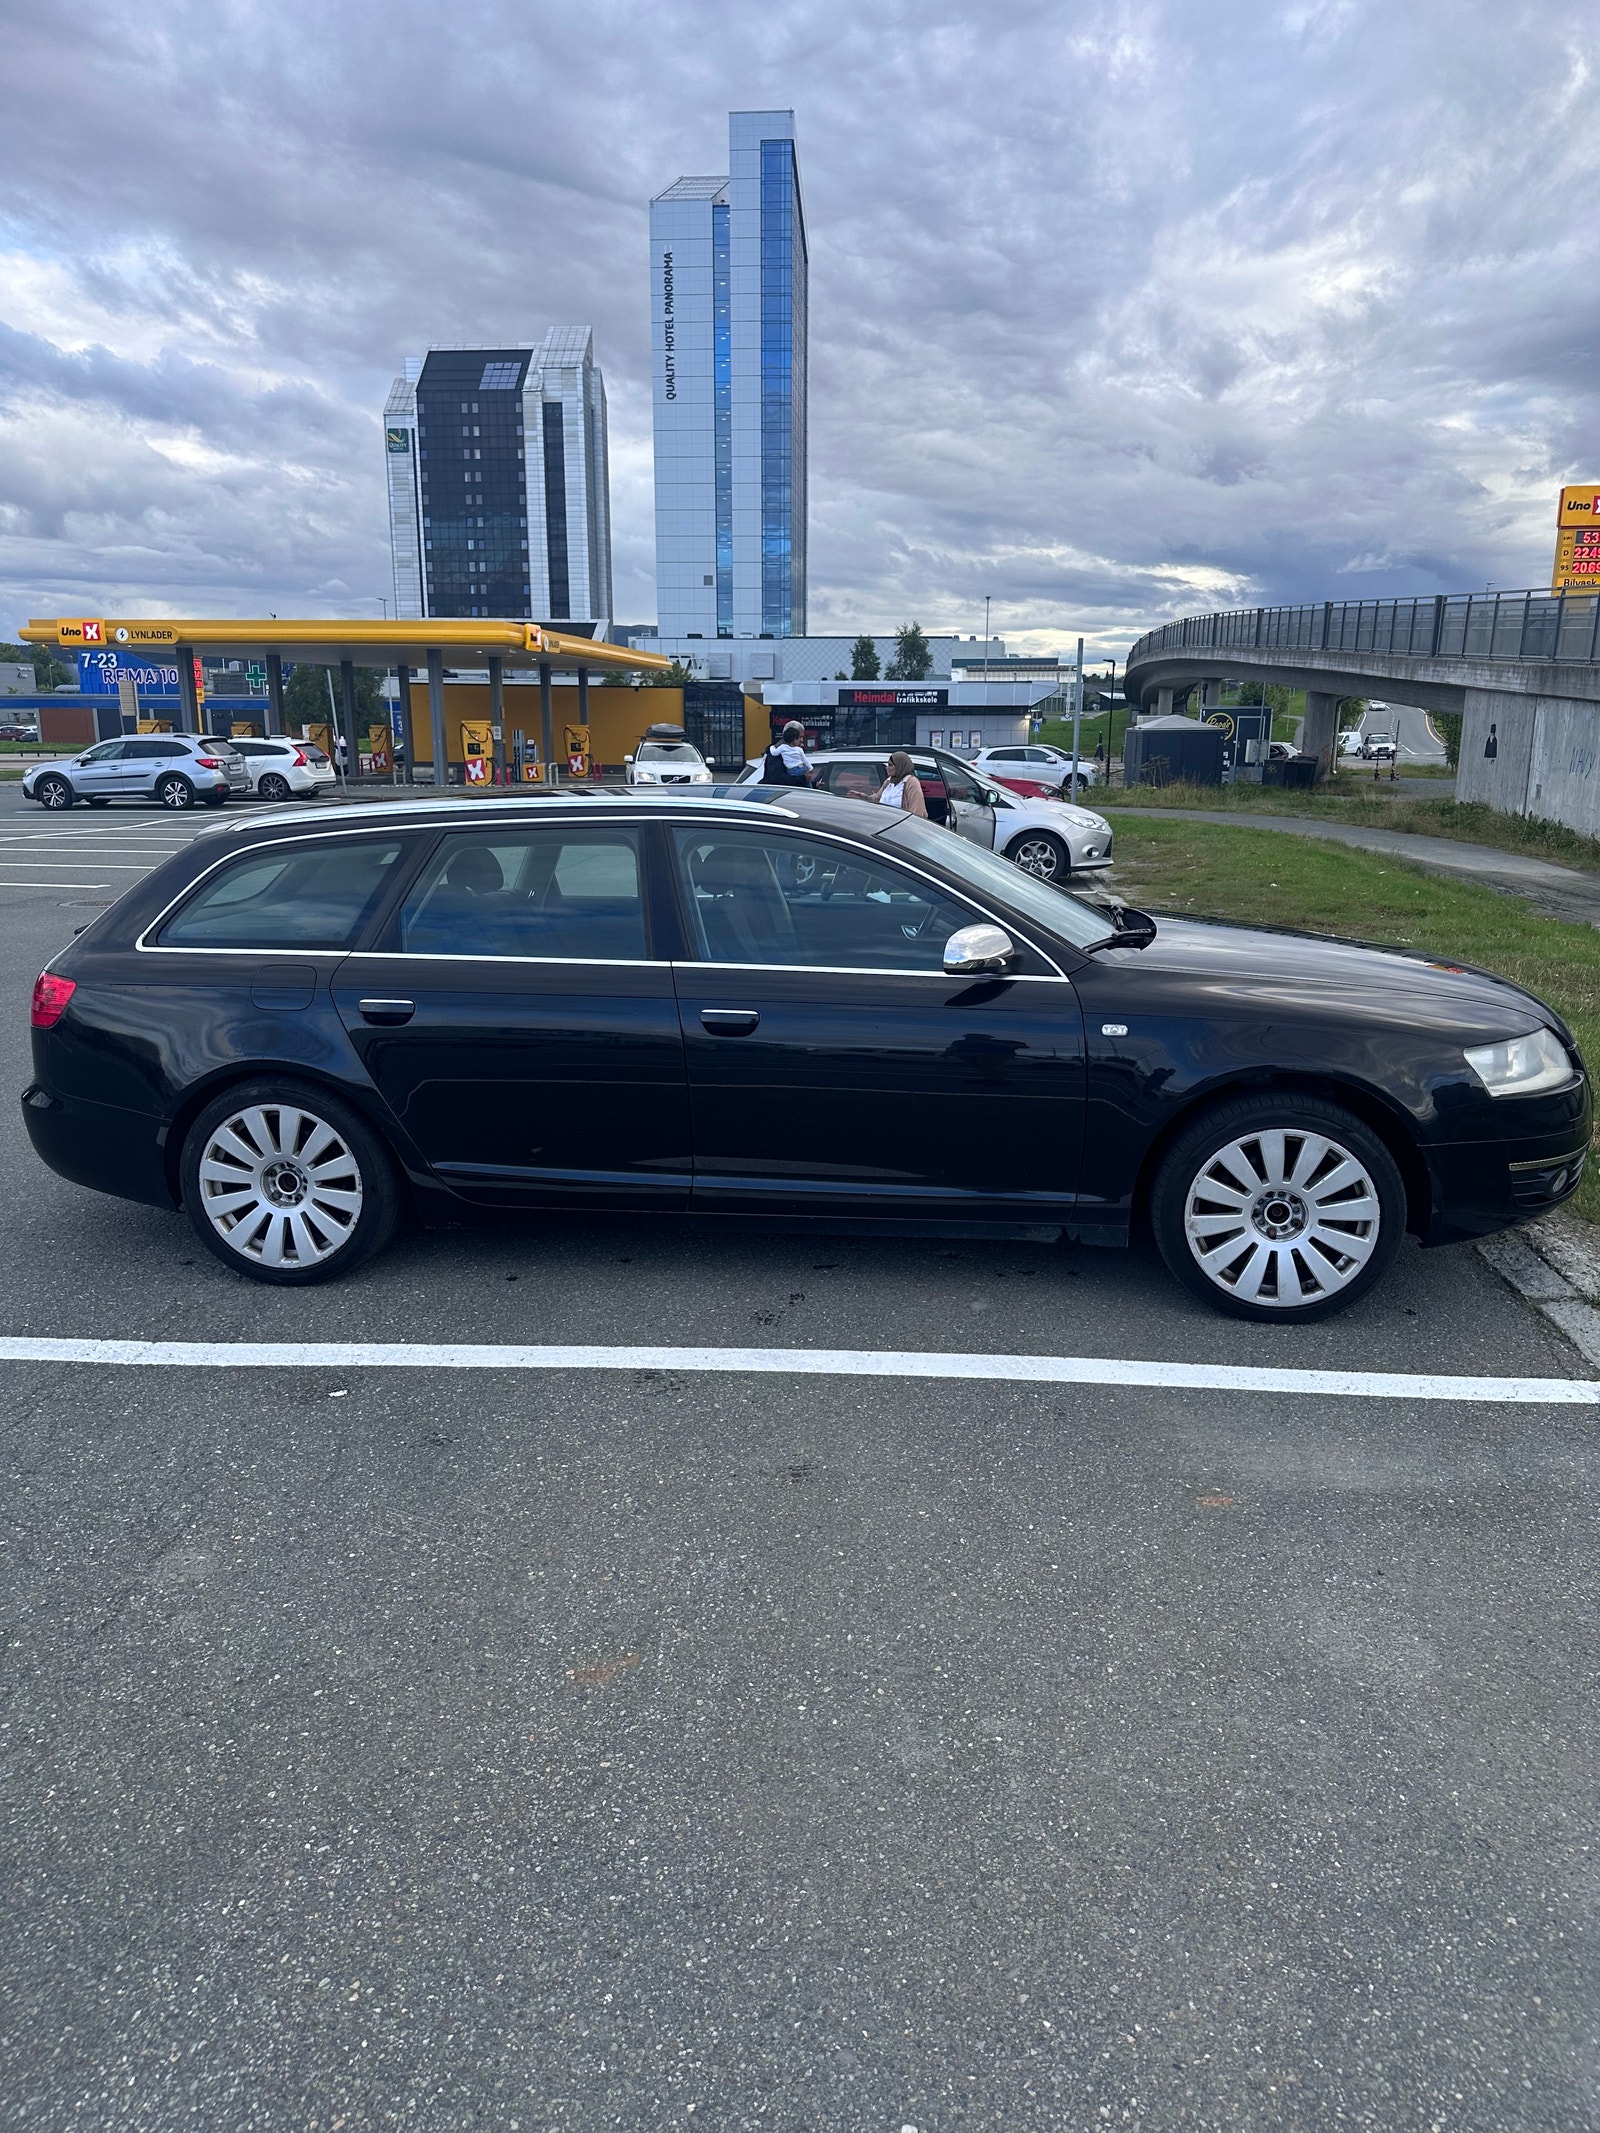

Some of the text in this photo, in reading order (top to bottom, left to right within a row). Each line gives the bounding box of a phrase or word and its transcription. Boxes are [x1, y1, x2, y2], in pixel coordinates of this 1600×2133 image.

[664, 252, 676, 400] QUALITY HOTEL PANORAMA
[1567, 501, 1591, 510] Uno
[61, 624, 98, 640] Uno X
[130, 631, 173, 639] LYNLADER
[81, 653, 118, 668] 7-23
[854, 691, 896, 703] Heimdal
